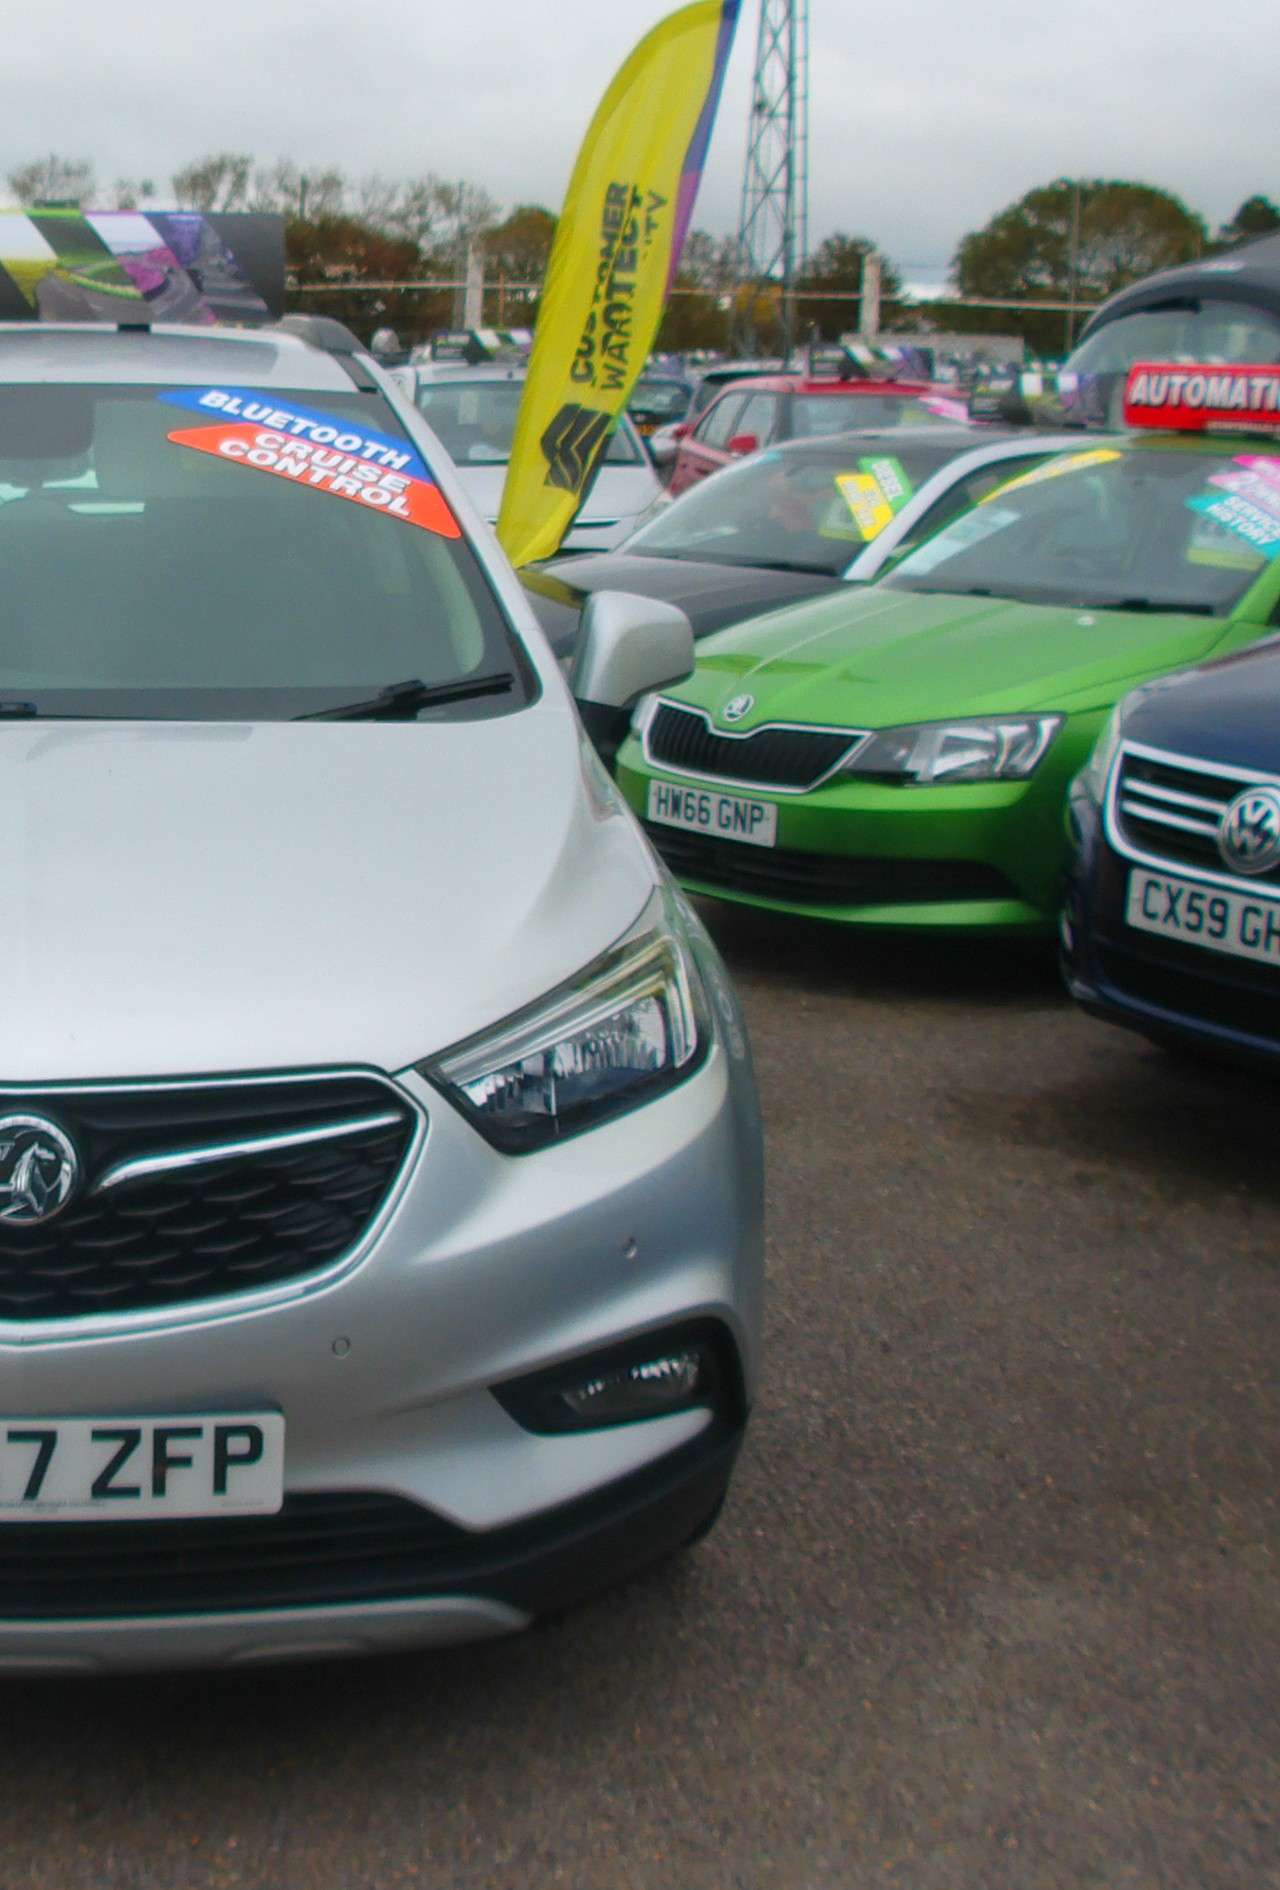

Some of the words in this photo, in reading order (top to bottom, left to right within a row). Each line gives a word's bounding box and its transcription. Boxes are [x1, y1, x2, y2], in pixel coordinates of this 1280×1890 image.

[1129, 374, 1280, 410] AUTOMATI
[198, 389, 412, 471] BLUETOOTH
[253, 431, 412, 495] CRUISE
[218, 438, 412, 517] CONTROL
[656, 785, 711, 826] HW66
[718, 798, 764, 834] GNP
[1142, 879, 1229, 940] CX59
[1240, 905, 1280, 954] GH
[91, 1424, 264, 1498] ZFP
